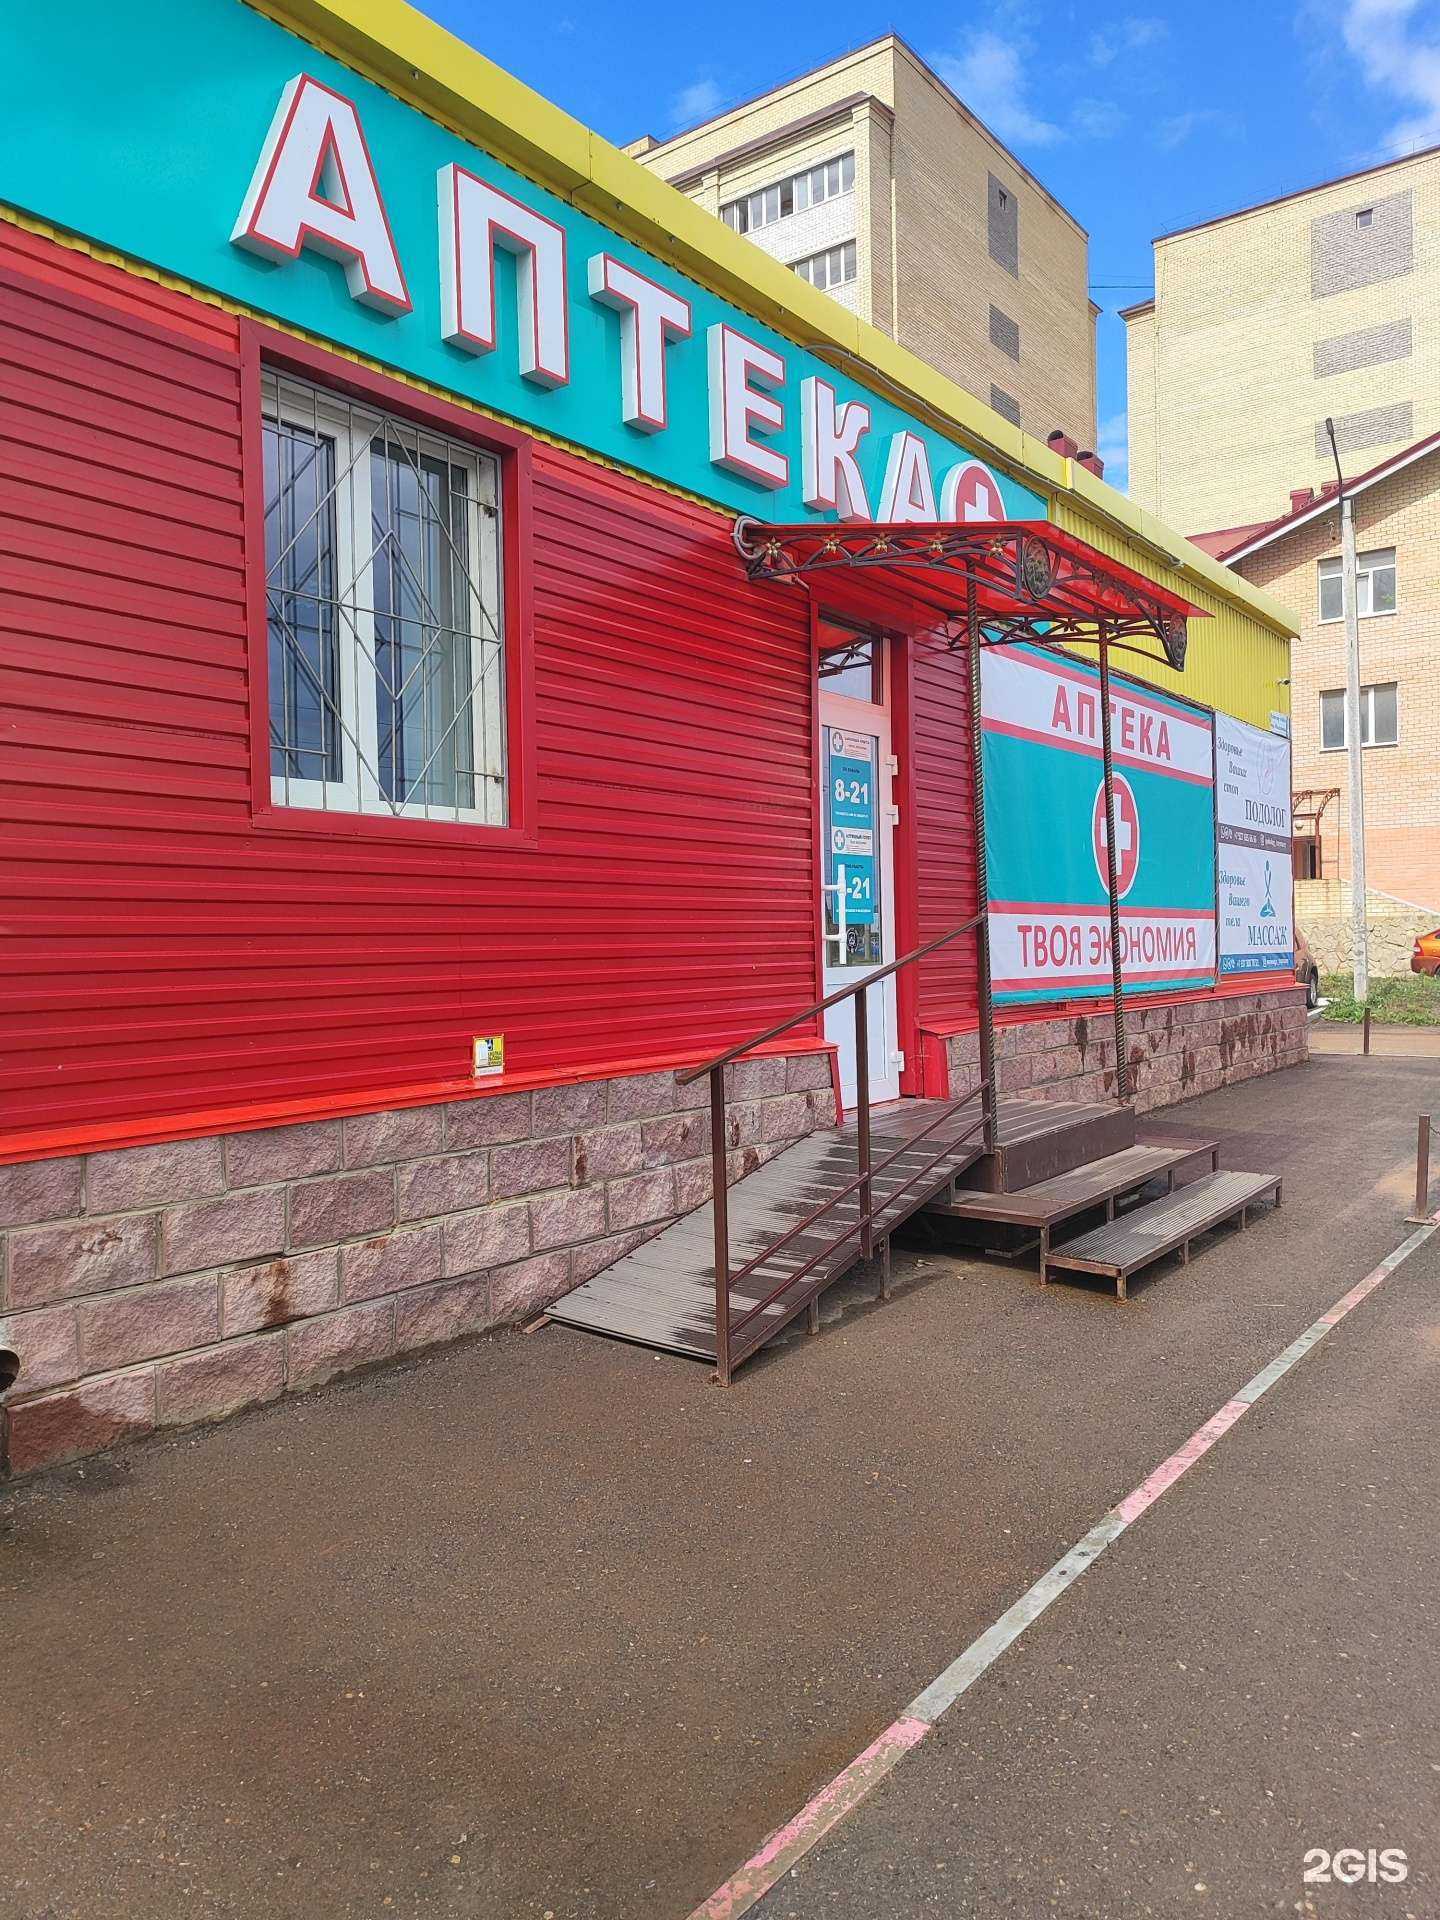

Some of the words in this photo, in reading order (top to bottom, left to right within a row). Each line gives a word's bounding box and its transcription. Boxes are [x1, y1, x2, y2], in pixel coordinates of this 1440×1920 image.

[230, 72, 939, 524] АПТЕКА
[1051, 684, 1171, 760] АПЕКА
[834, 778, 869, 804] 8-21
[1245, 800, 1287, 828] ПОДОЛОГ
[837, 876, 870, 899] -21
[1017, 925, 1082, 967] ТВОЯ
[1089, 925, 1197, 966] ЭКОНОМИЯ
[1247, 925, 1288, 946] МАССАЖ
